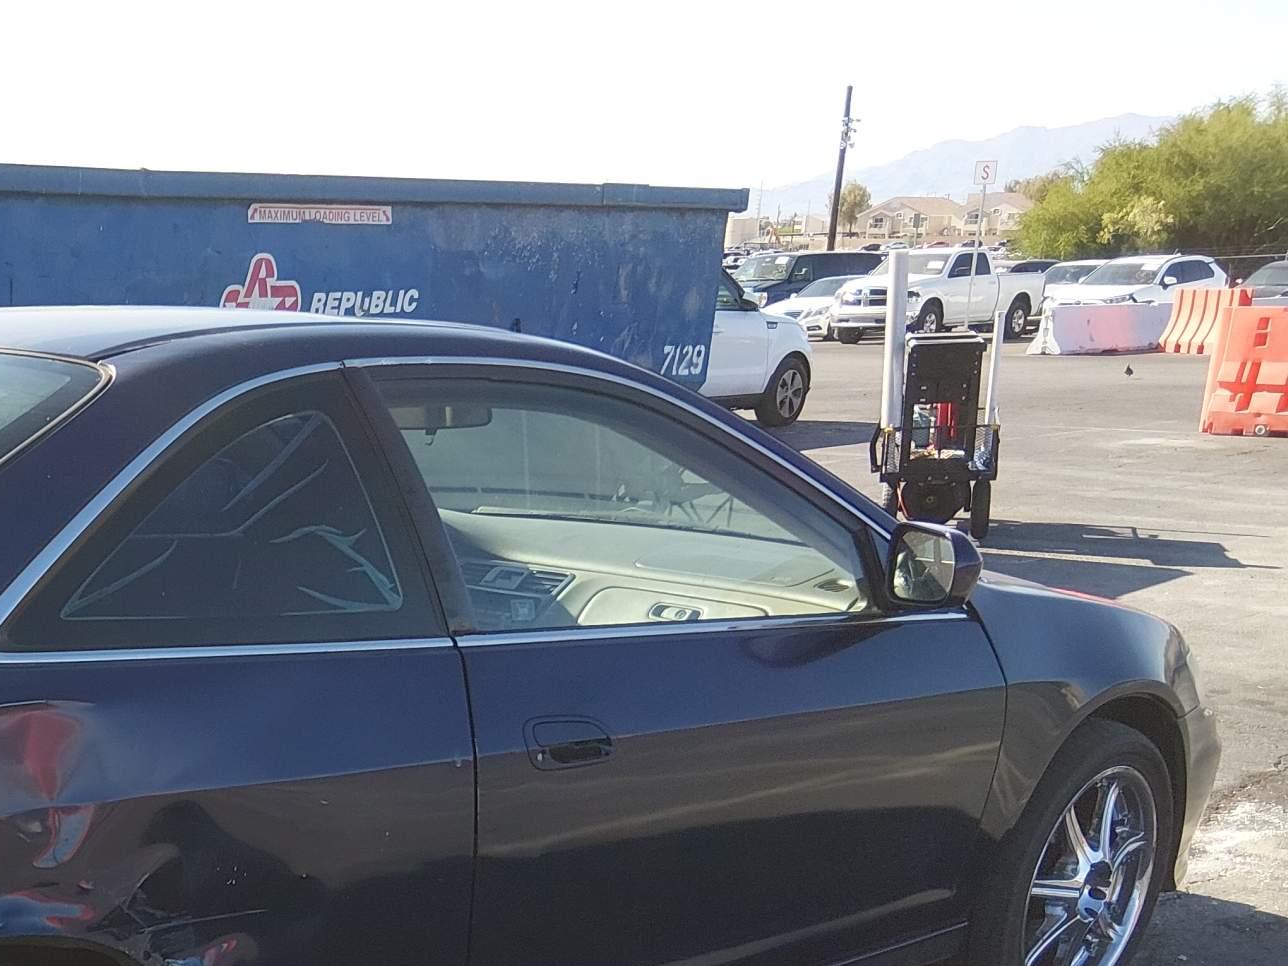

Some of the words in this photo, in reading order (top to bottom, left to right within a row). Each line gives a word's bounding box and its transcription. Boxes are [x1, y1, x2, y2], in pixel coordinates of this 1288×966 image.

[981, 165, 990, 180] S
[258, 208, 305, 221] MAXIMUM
[308, 210, 351, 221] LOADING
[353, 211, 381, 222] LEVEL
[310, 288, 419, 317] REPUBLIC
[660, 344, 706, 376] 7129
